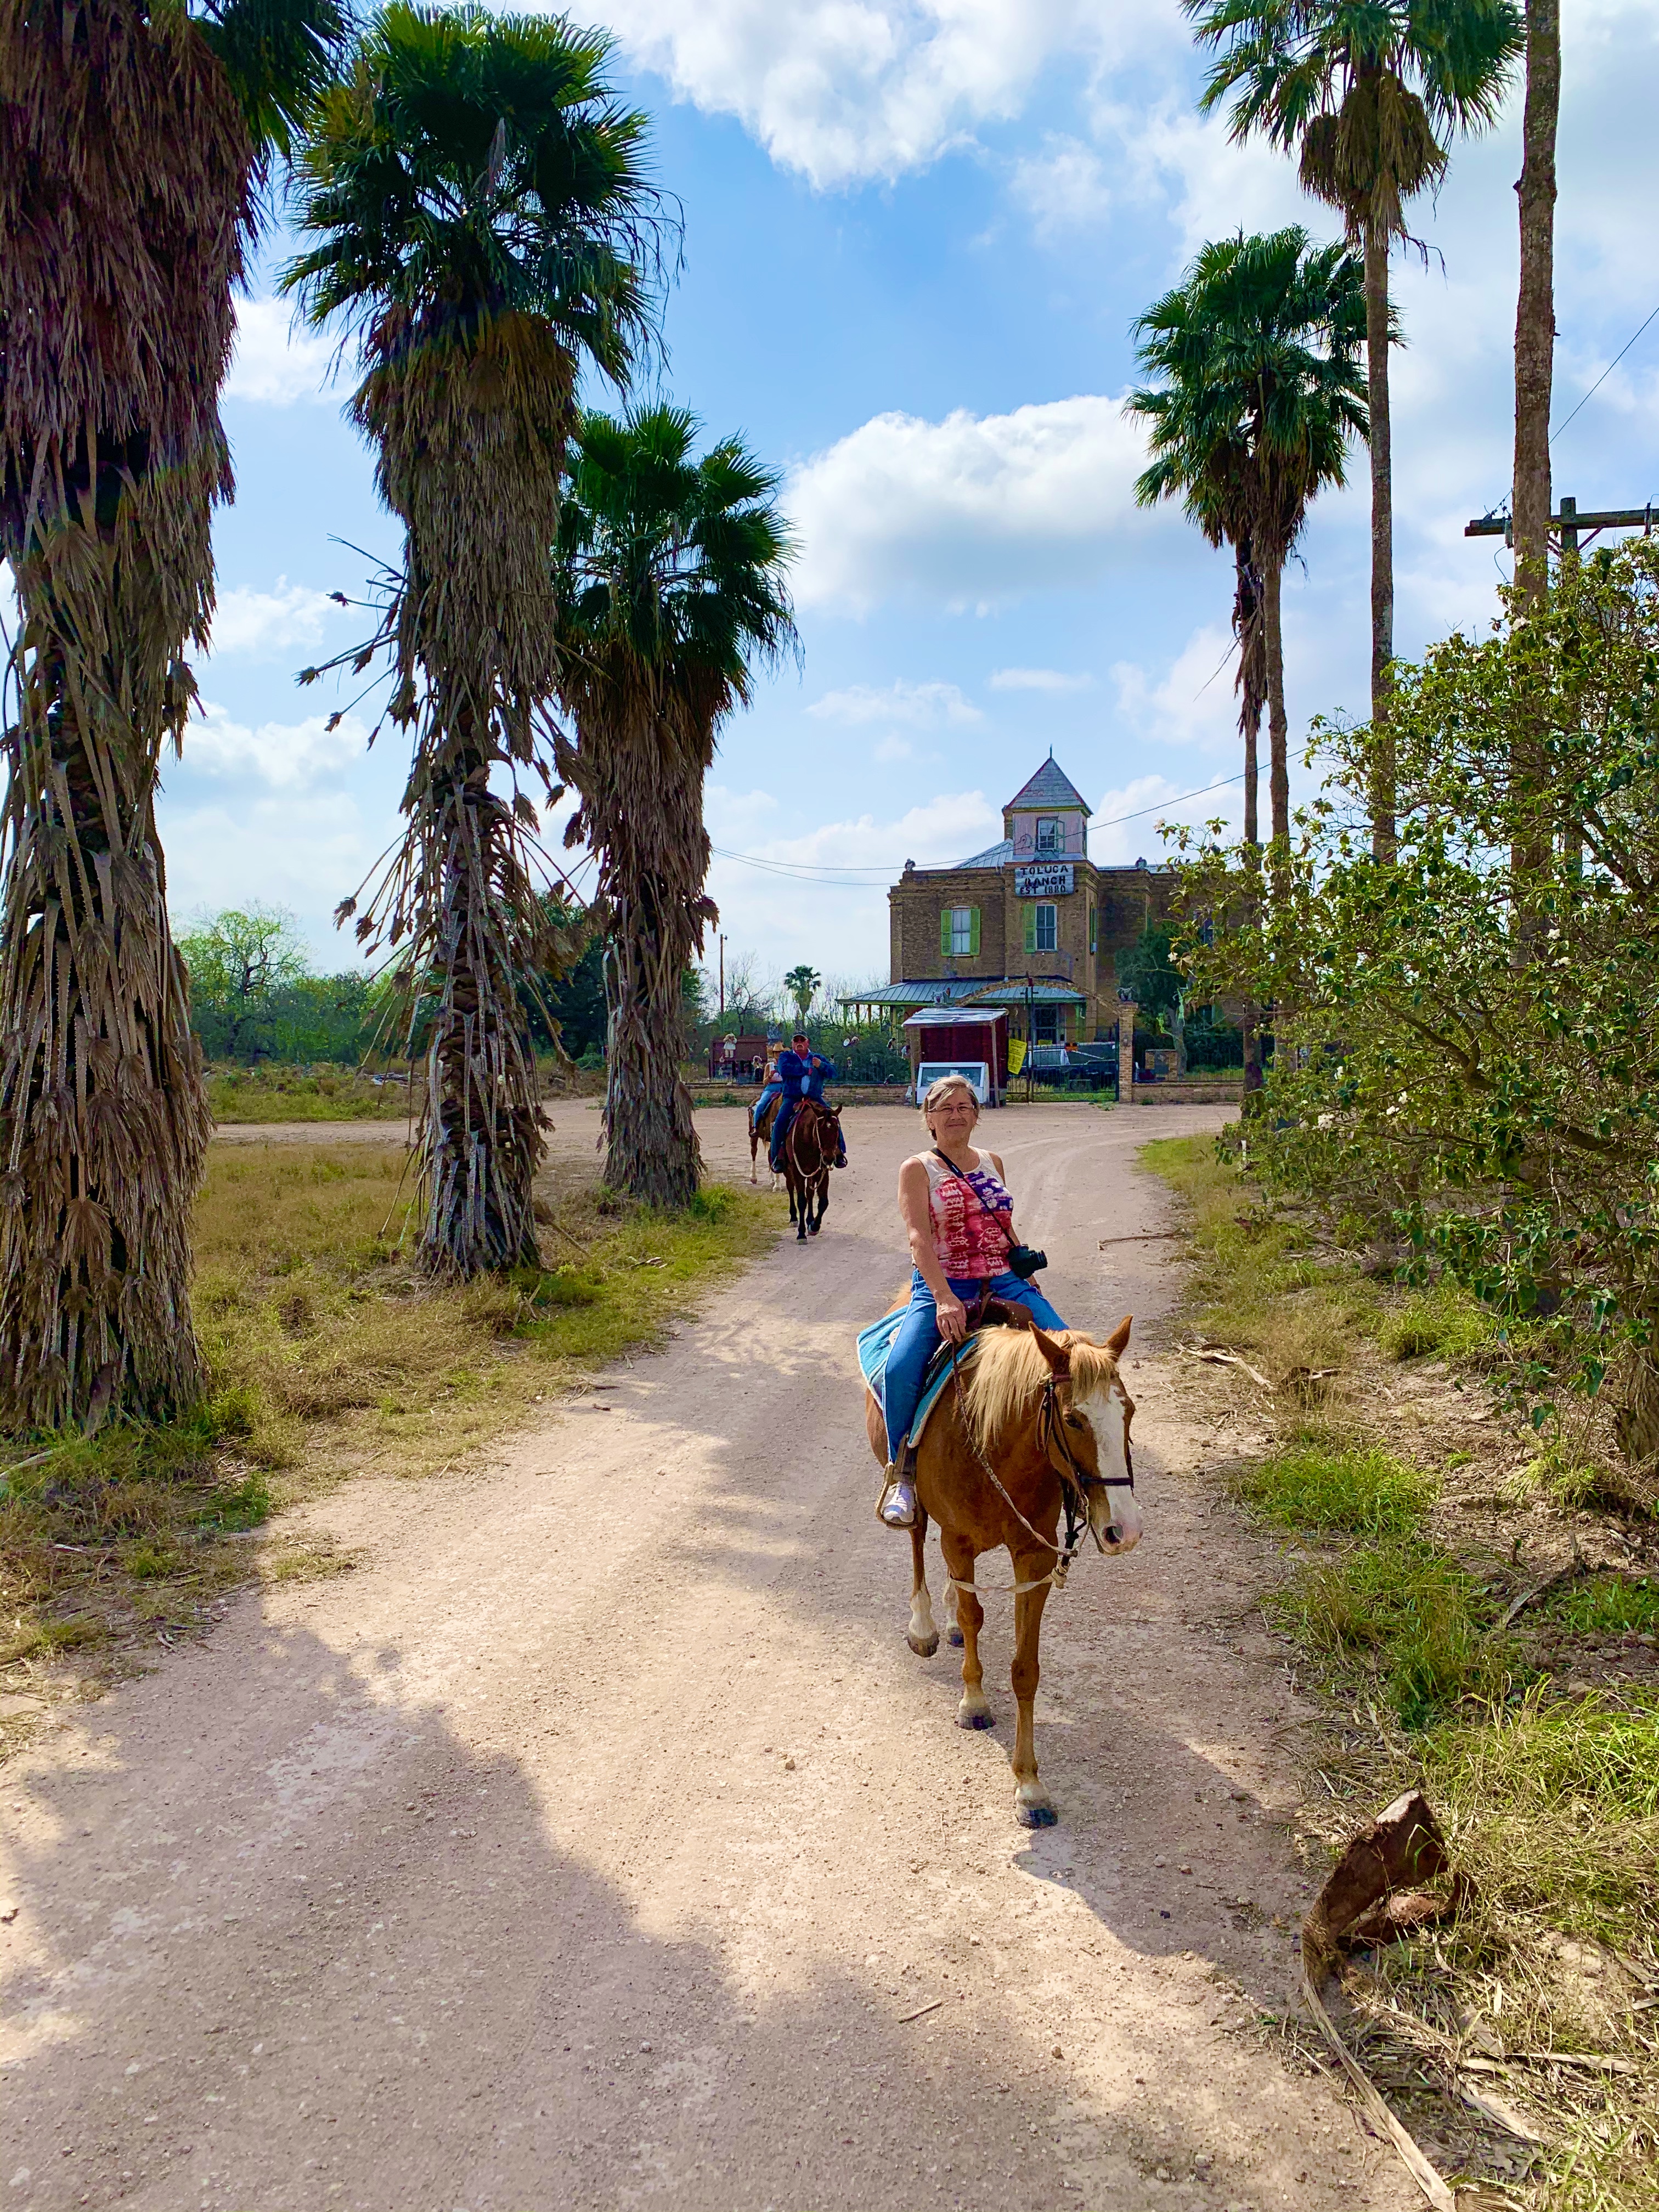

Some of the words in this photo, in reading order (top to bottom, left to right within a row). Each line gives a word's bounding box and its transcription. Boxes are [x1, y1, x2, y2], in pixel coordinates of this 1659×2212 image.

[1020, 865, 1068, 876] TOLUCA
[1025, 876, 1065, 886] RANCH
[1020, 886, 1038, 894] EST
[1045, 885, 1065, 894] 1880
